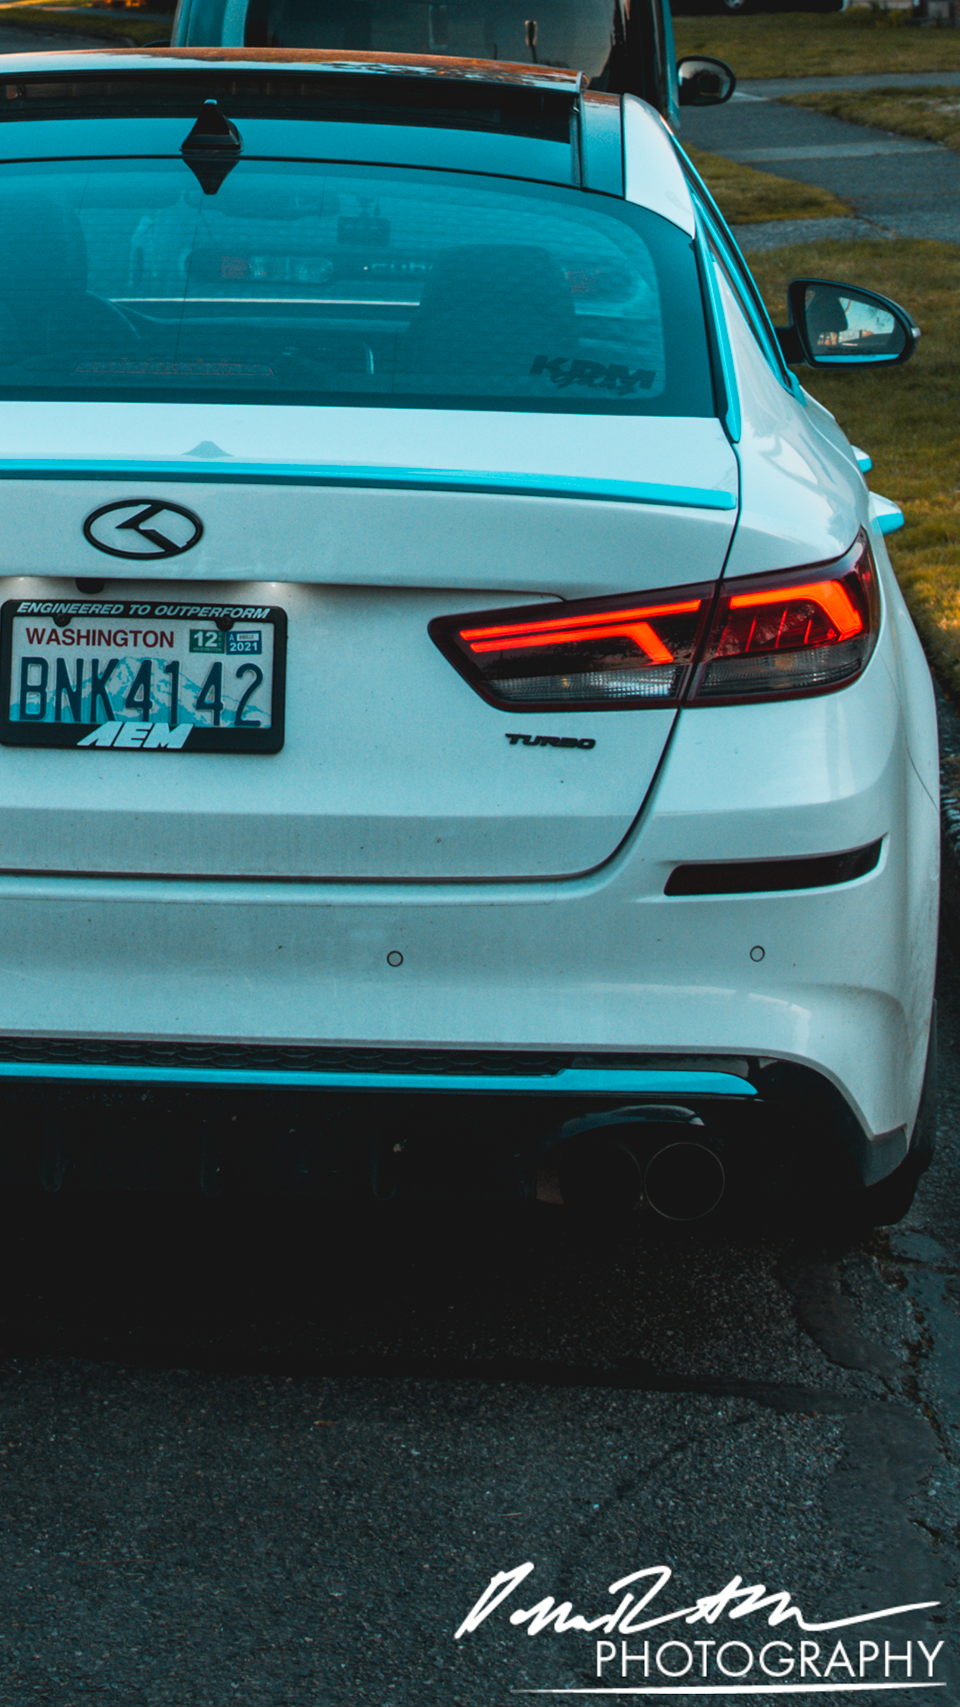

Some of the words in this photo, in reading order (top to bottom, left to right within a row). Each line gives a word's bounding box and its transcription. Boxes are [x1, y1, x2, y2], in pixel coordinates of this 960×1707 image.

[17, 602, 124, 615] ENGINEERED
[128, 605, 151, 616] TO
[154, 606, 271, 619] OUTPERFORM
[25, 627, 175, 648] WASHINGTON
[193, 631, 218, 647] 12
[229, 642, 258, 652] 2021
[20, 656, 263, 727] BNK4142
[77, 720, 194, 749] AEM
[505, 733, 596, 749] TURBO
